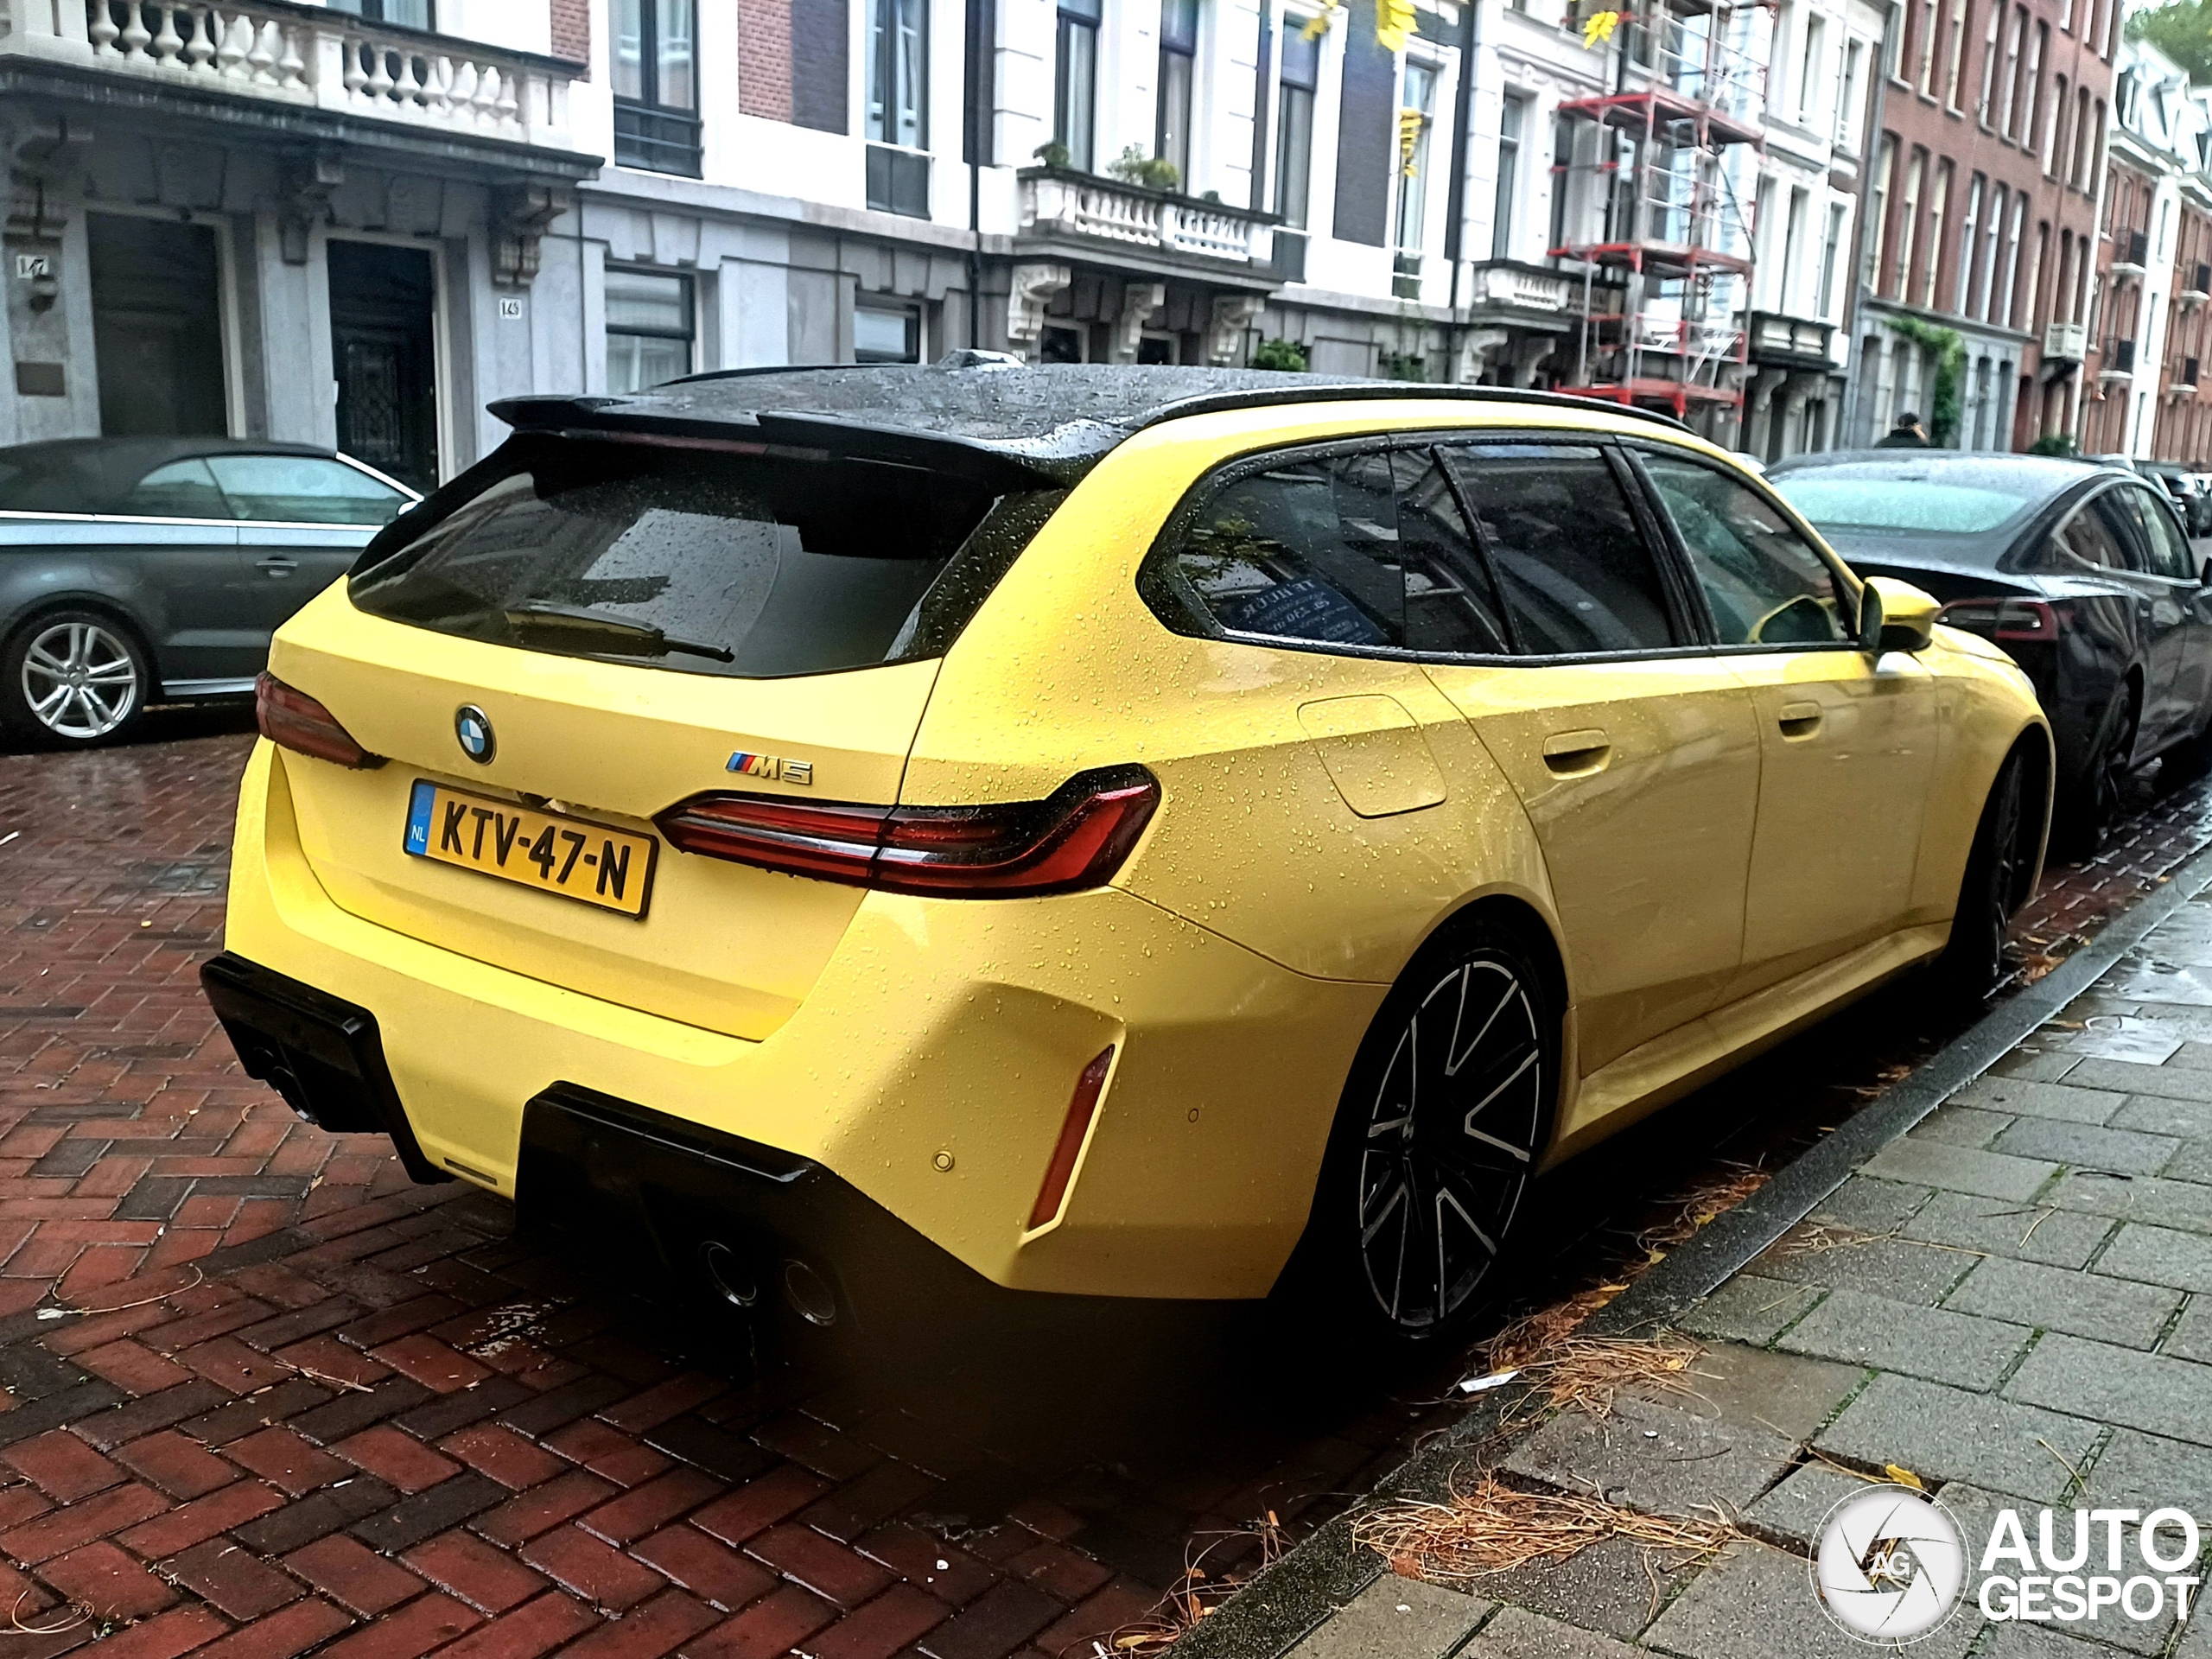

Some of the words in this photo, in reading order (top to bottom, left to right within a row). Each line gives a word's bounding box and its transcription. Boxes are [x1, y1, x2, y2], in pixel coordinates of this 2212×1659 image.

[745, 753, 813, 785] M5
[410, 823, 425, 842] NL
[440, 800, 631, 900] KTV-47-N
